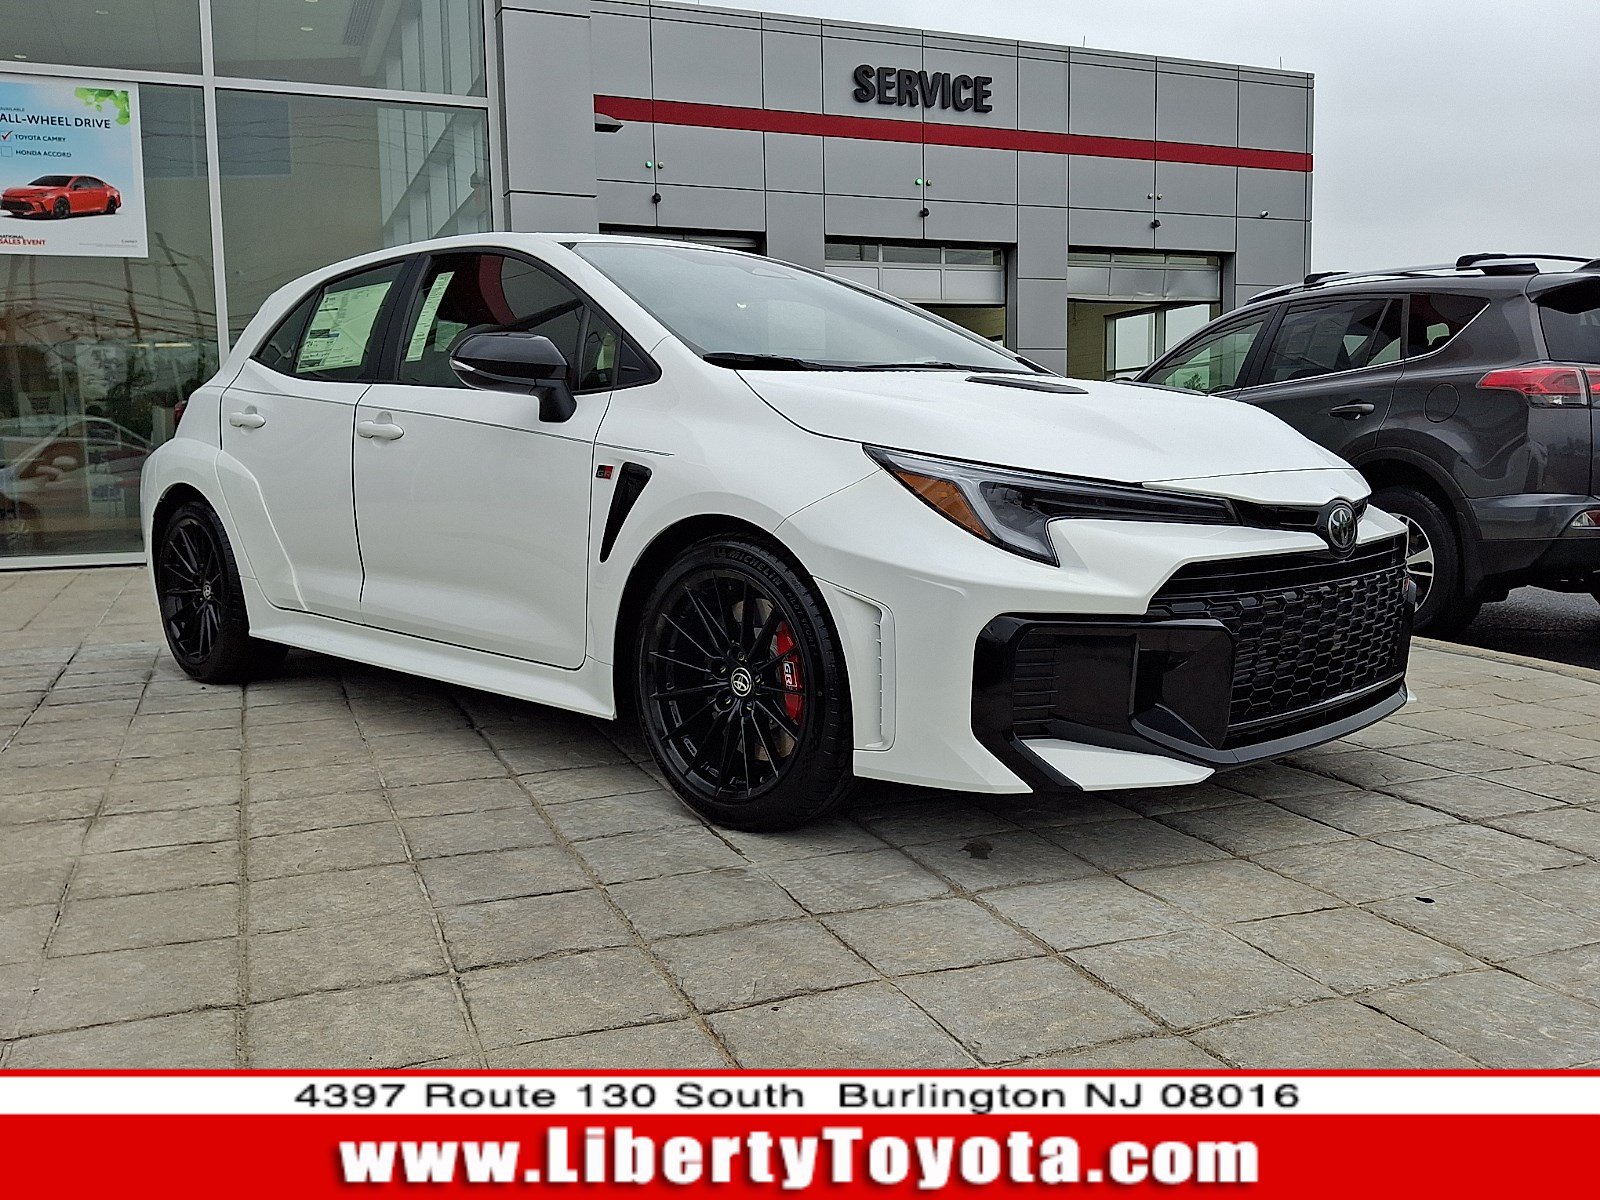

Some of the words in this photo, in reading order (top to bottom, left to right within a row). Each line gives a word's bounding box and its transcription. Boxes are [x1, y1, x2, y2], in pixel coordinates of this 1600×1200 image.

[854, 64, 992, 112] SERVICE
[0, 113, 71, 127] ALL-WHEEL
[74, 117, 111, 129] DRIVE
[43, 150, 72, 158] ACCORD
[727, 551, 783, 586] MICHELIN
[785, 592, 804, 615] PILOT
[801, 617, 816, 649] SPORT
[783, 661, 793, 687] GR
